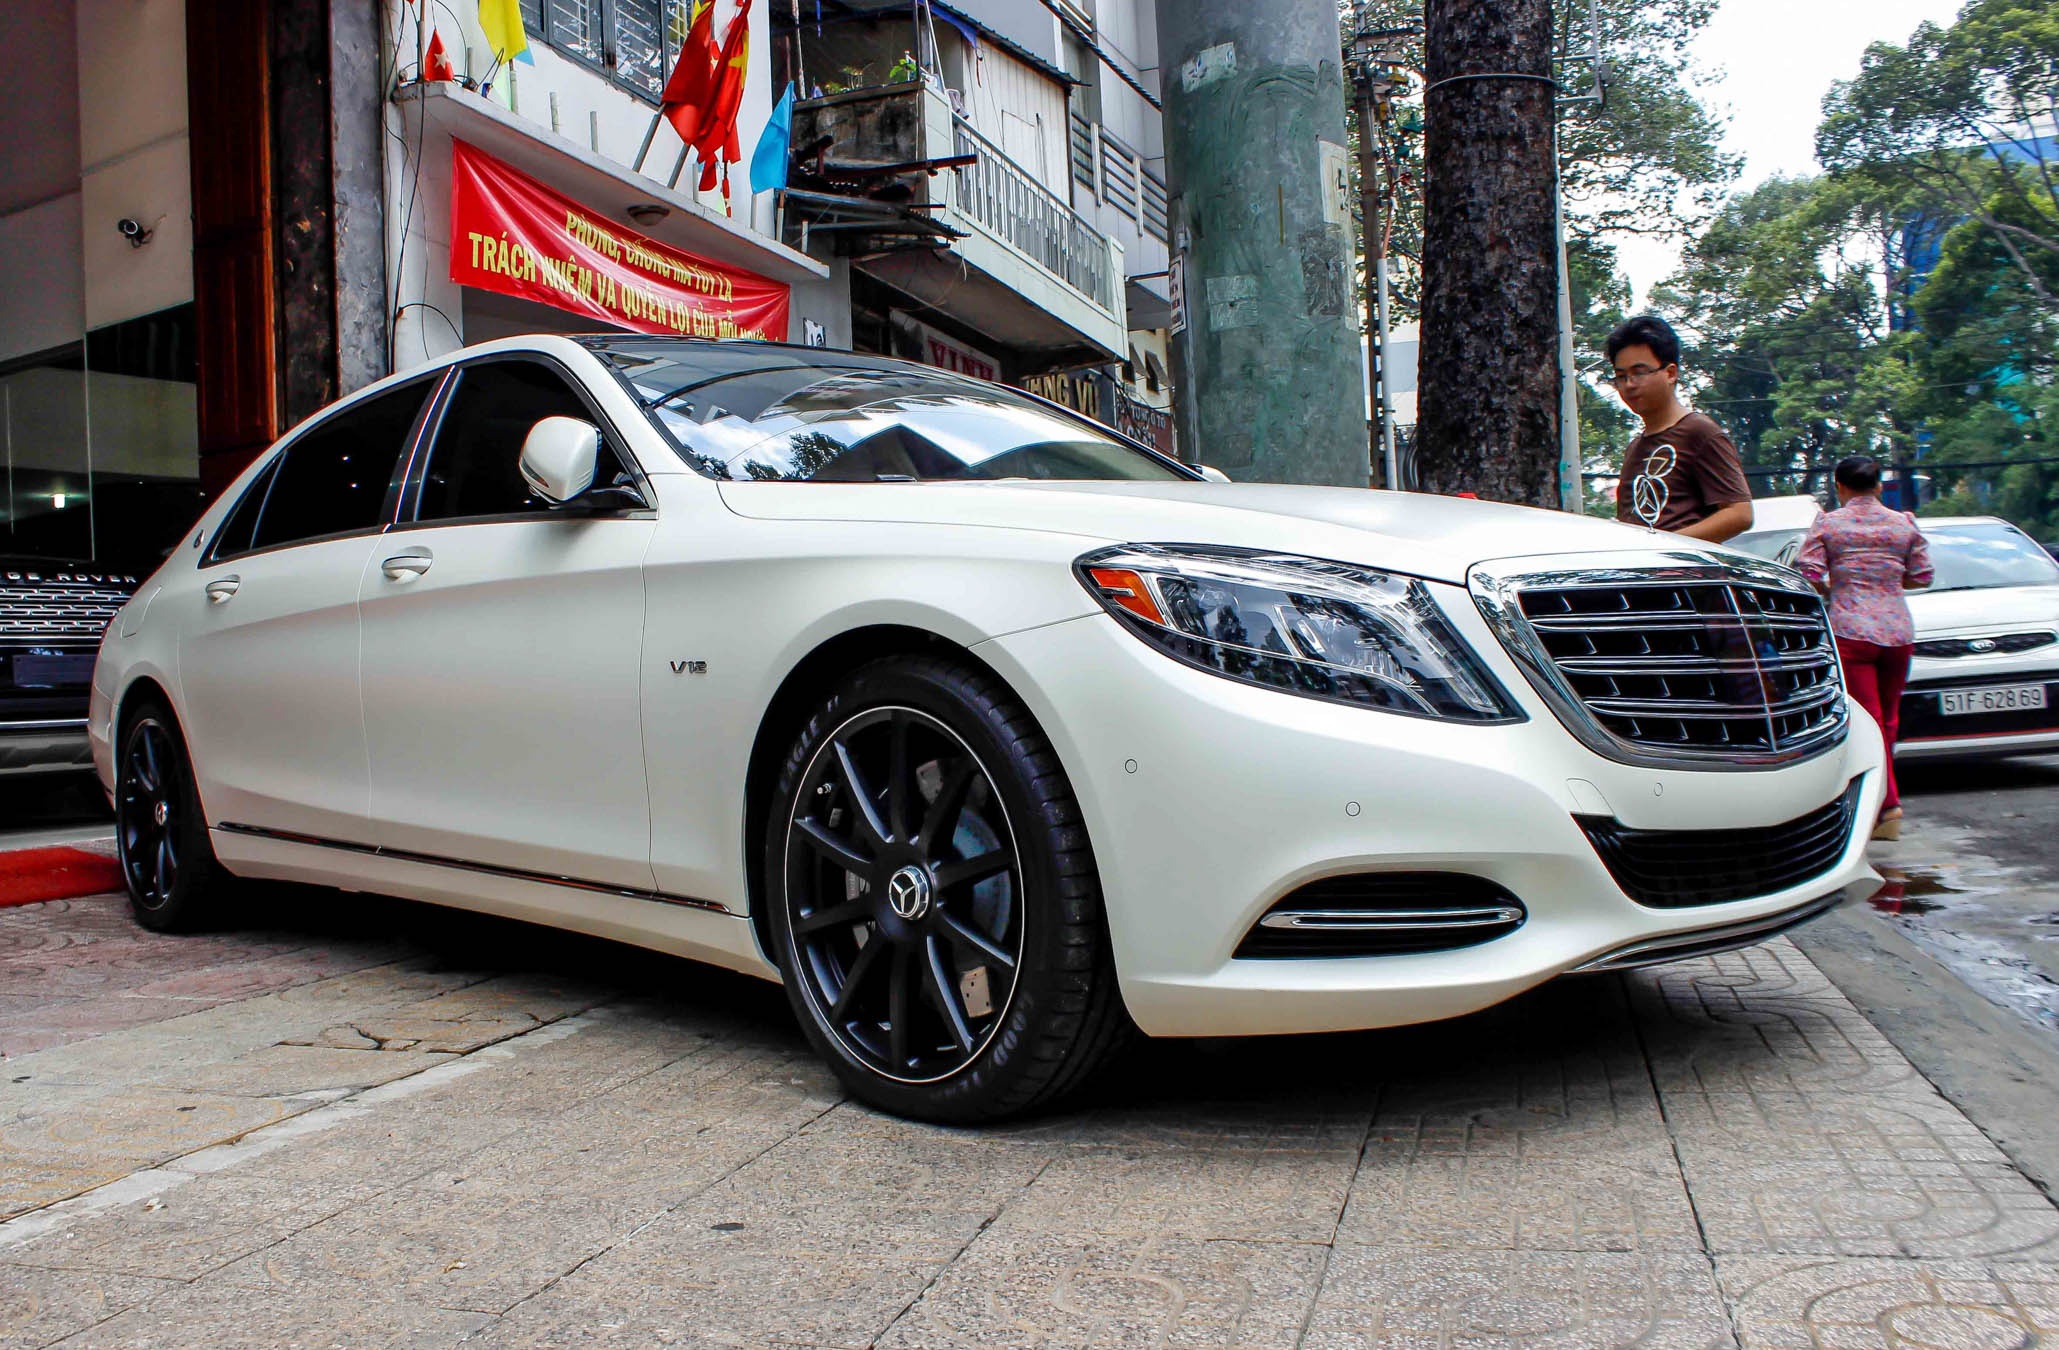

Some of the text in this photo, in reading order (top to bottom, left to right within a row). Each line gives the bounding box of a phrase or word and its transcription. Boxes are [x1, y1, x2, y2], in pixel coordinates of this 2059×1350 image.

[469, 231, 536, 283] TRÁCH
[542, 255, 592, 302] NHIỆM
[668, 300, 690, 335] LỢI
[693, 302, 716, 337] CỦA
[716, 272, 733, 303] LÀ
[57, 573, 136, 583] ROVER
[670, 660, 707, 674] V12
